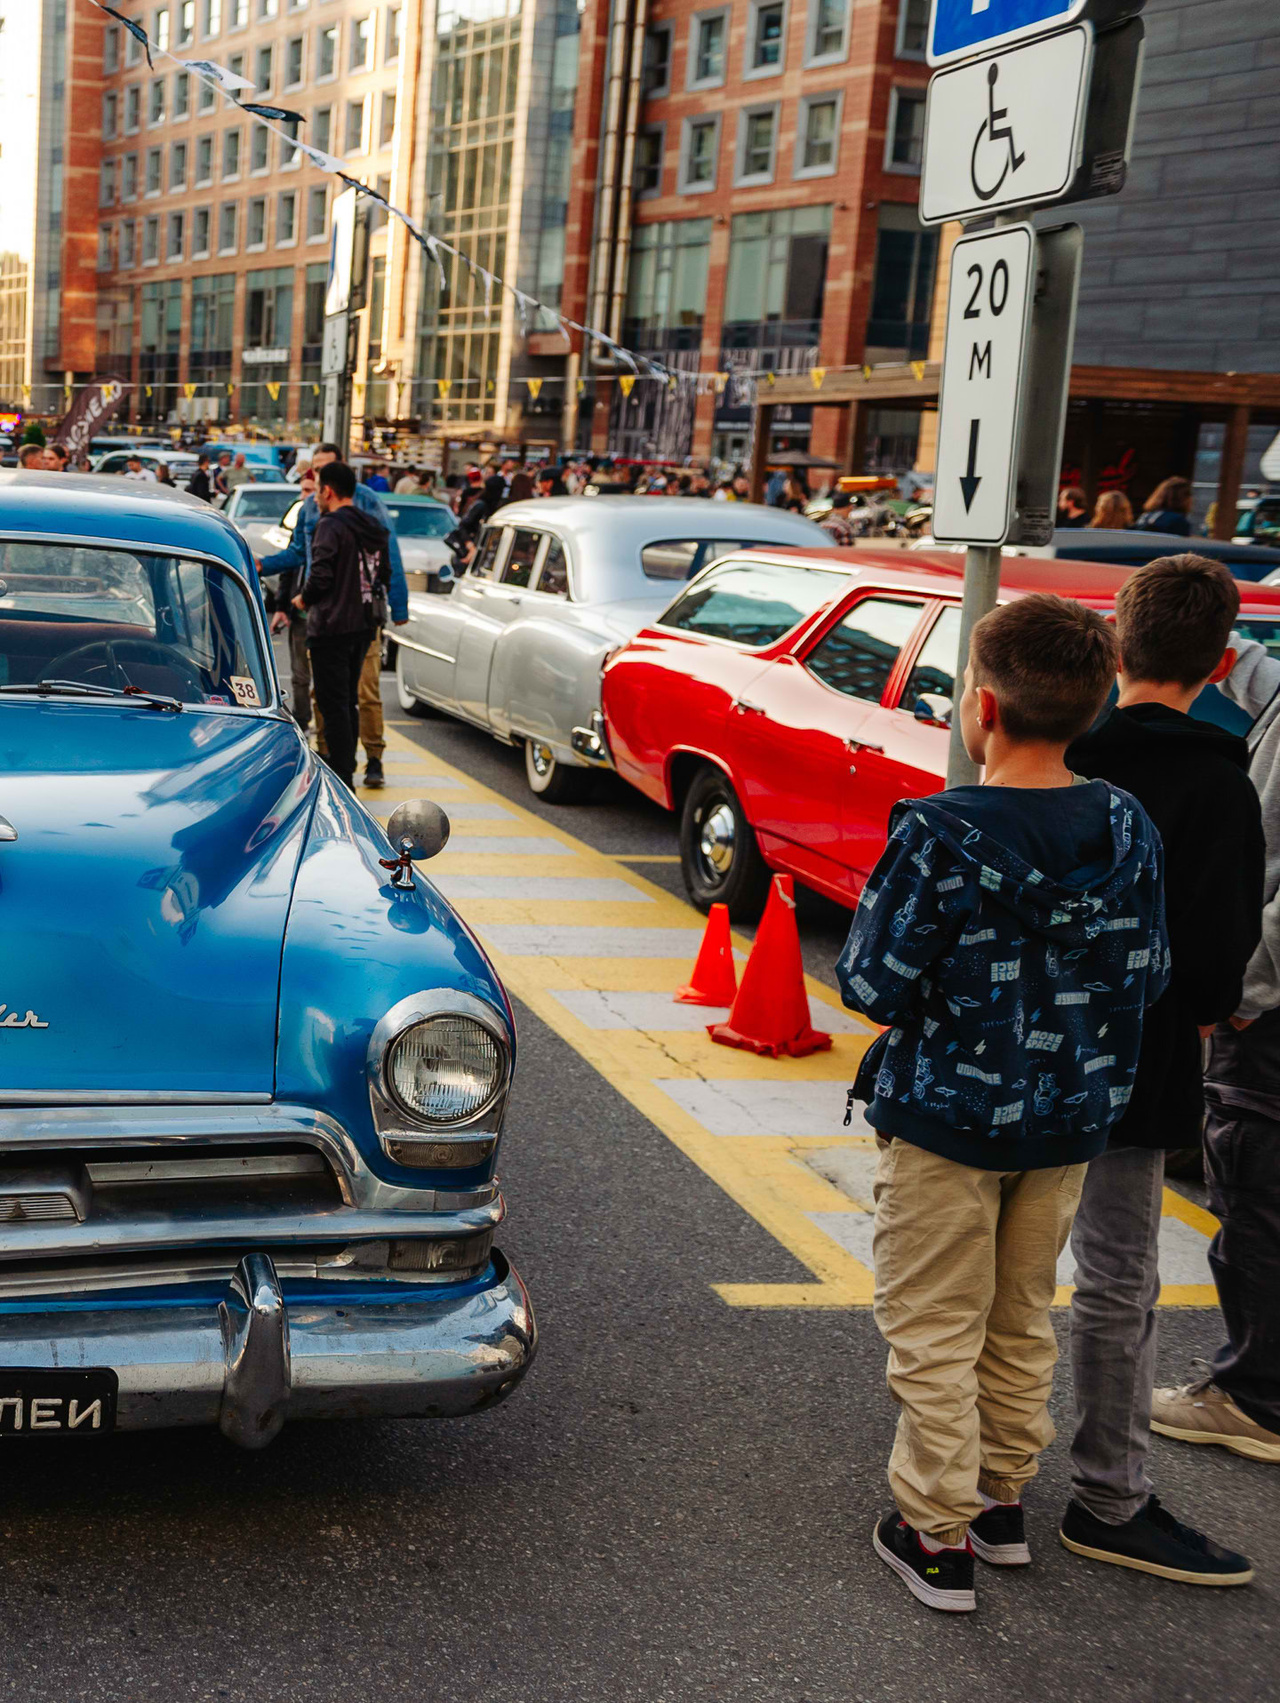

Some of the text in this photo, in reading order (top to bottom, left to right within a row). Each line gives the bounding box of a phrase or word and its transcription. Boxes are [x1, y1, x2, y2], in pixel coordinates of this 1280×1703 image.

[964, 258, 1009, 319] 20
[968, 340, 992, 381] М
[235, 682, 256, 699] 38
[1030, 1030, 1065, 1043] MORE
[1025, 1039, 1060, 1052] SPACE
[992, 1110, 1022, 1125] MORE
